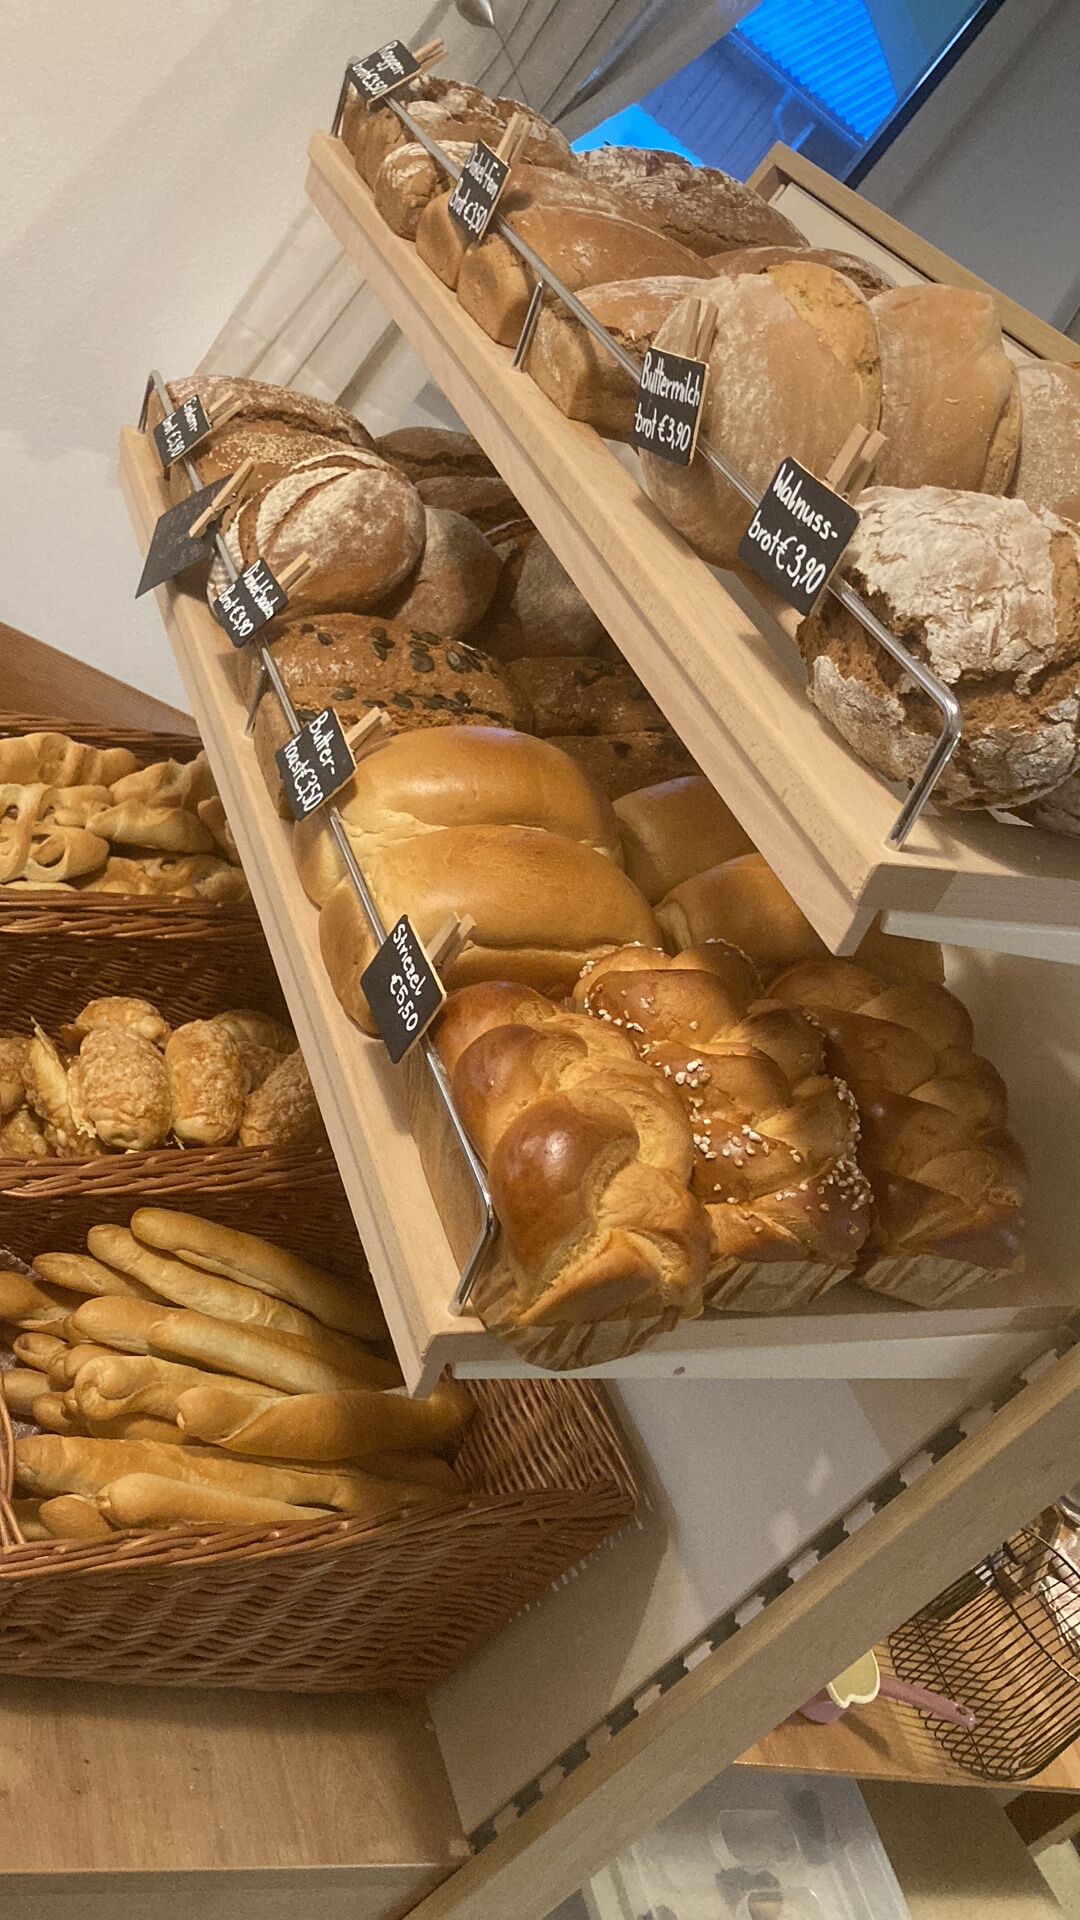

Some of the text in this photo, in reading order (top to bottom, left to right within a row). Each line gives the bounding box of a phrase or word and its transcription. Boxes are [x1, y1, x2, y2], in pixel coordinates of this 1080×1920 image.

[377, 41, 404, 75] Roggen-
[641, 351, 700, 407] Buttermilch
[634, 402, 692, 452] brot €3,90
[773, 463, 838, 540] Walnuss-
[309, 710, 335, 775] Butter-
[393, 923, 427, 996] Striezel
[389, 973, 419, 1031] €5,50
